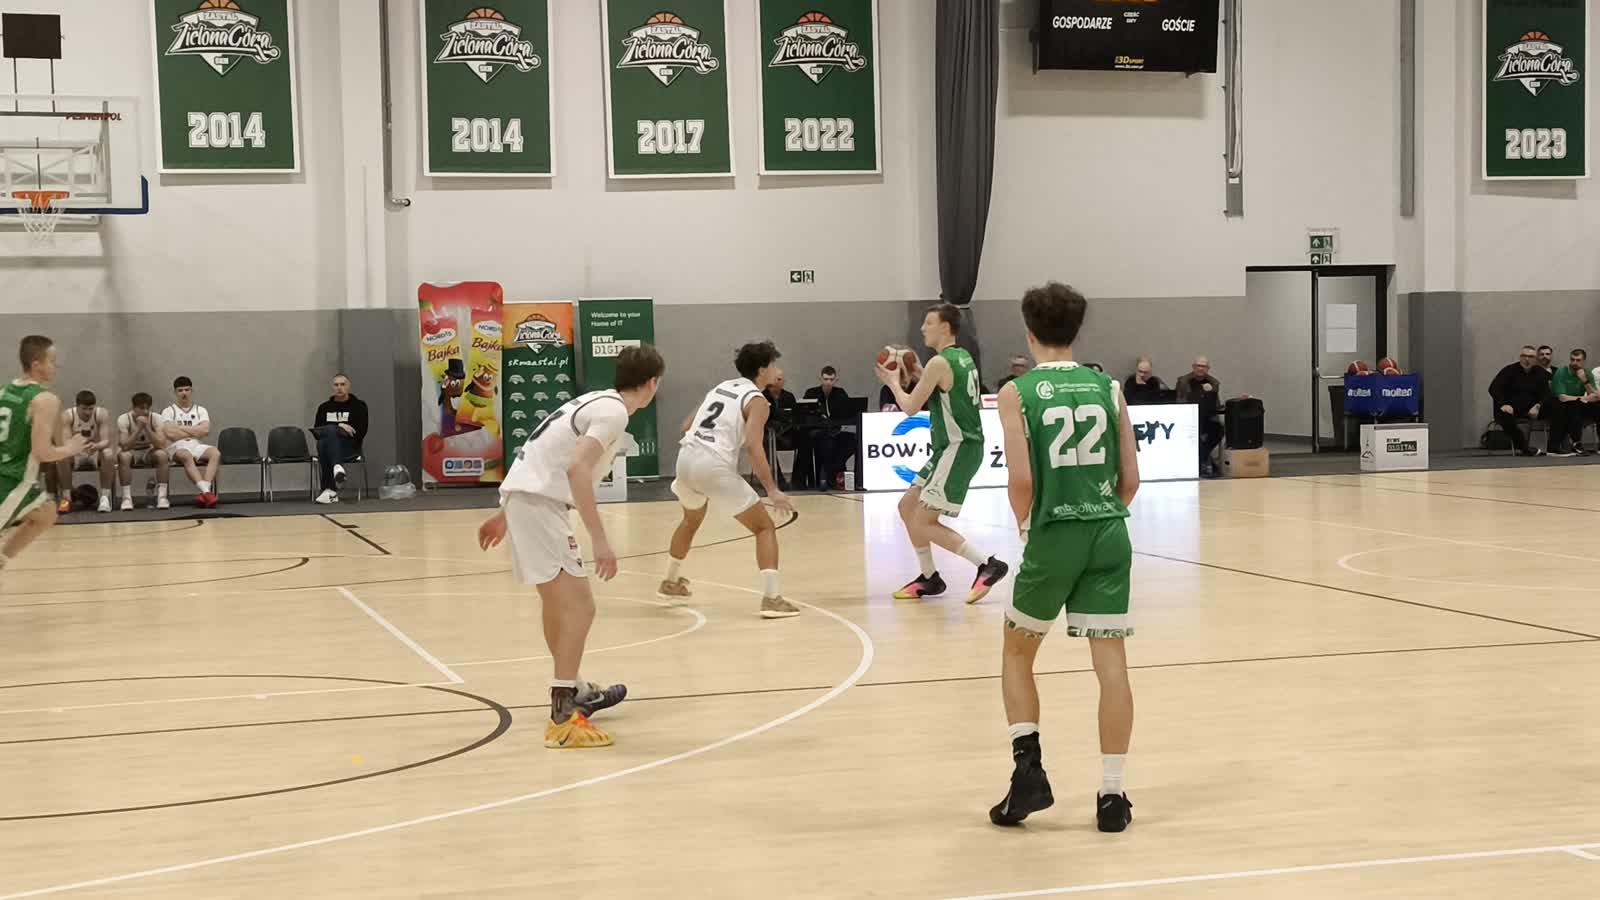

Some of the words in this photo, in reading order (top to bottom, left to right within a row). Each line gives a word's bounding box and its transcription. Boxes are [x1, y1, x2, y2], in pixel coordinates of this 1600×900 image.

[1052, 16, 1113, 30] GOSPODARZE
[1161, 17, 1196, 32] GOŚCIE
[187, 112, 265, 148] 2014
[452, 117, 524, 152] 2014
[637, 119, 705, 154] 2017
[784, 118, 855, 151] 2022
[1505, 128, 1567, 160] 2023
[428, 345, 460, 361] Bajka
[472, 337, 504, 352] Bajka
[1382, 388, 1413, 397] molten
[700, 401, 725, 430] 2
[1042, 404, 1108, 469] 22
